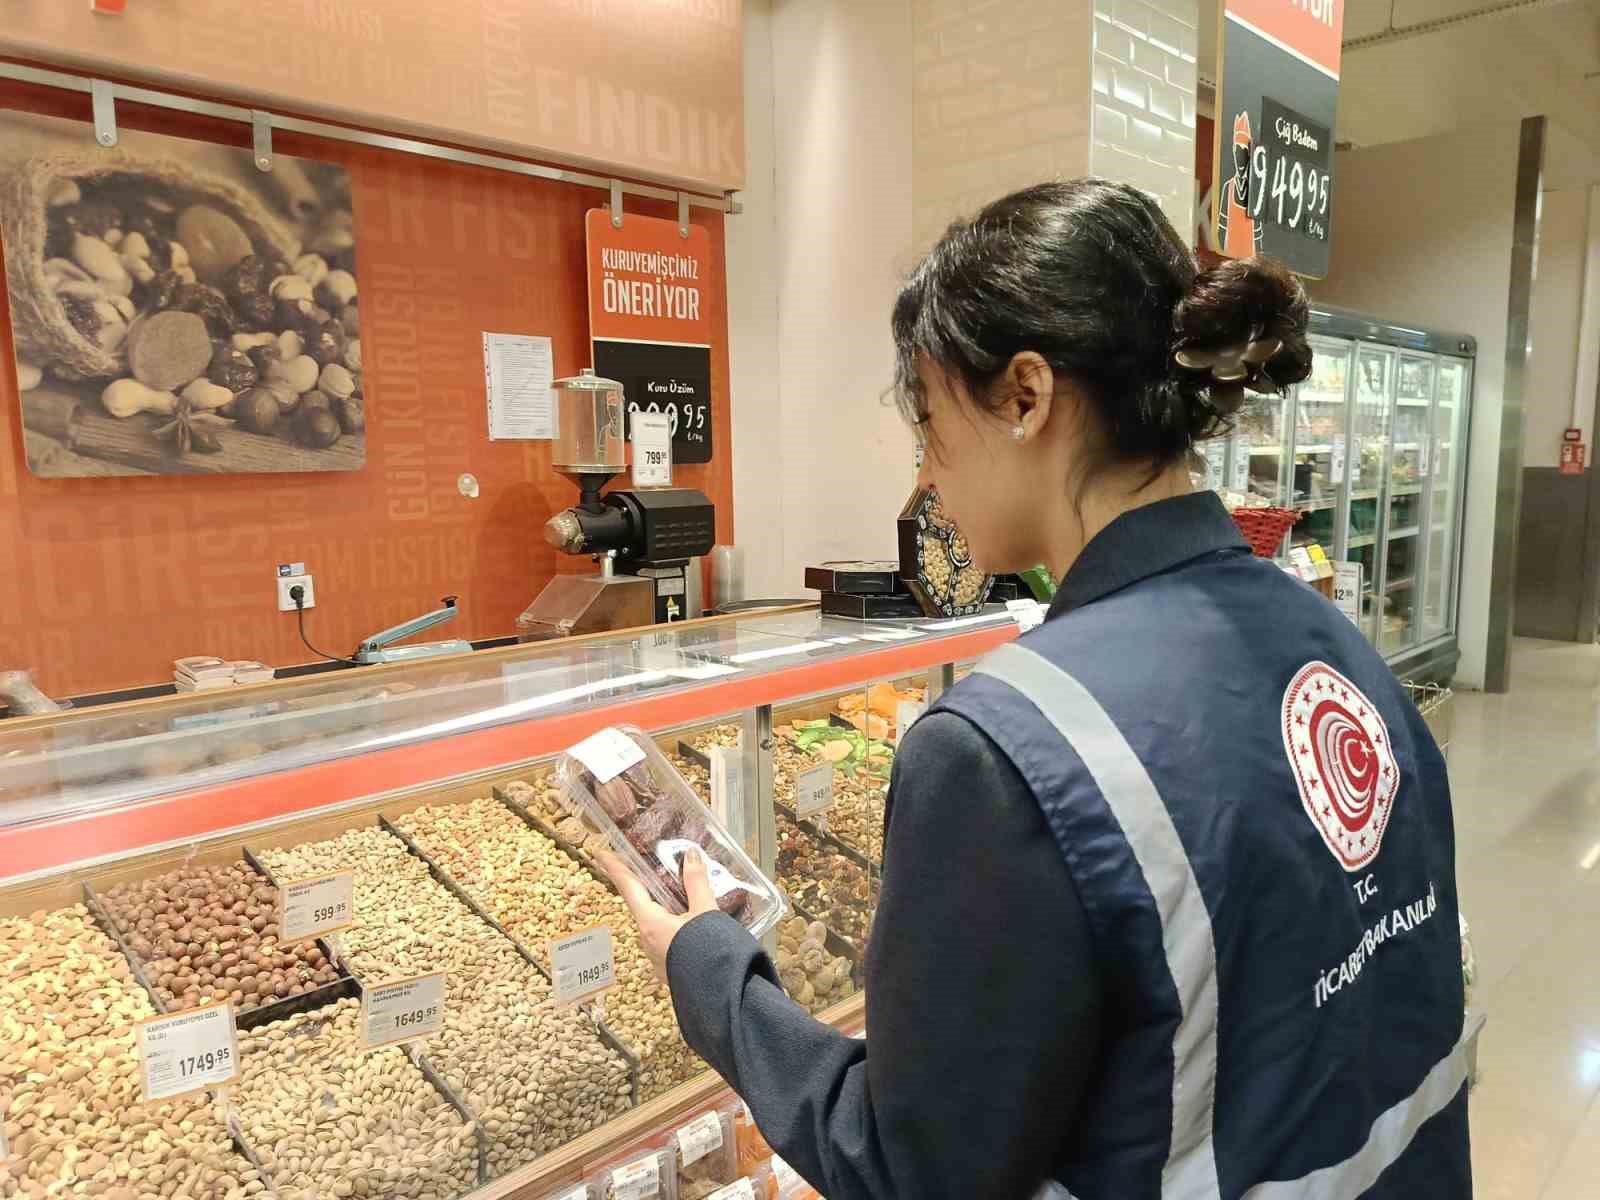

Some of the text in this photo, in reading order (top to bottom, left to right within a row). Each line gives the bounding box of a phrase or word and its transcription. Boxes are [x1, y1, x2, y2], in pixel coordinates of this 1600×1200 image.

[535, 64, 741, 178] FINDIK
[1292, 124, 1318, 151] Badem
[602, 247, 698, 281] KURUYEMİŞÇİNİZ
[603, 272, 700, 320] ÖNERİYOR
[647, 380, 695, 394] Kuru Üzüm
[1353, 873, 1378, 904] T.C.
[179, 1048, 230, 1077] 1749.95
